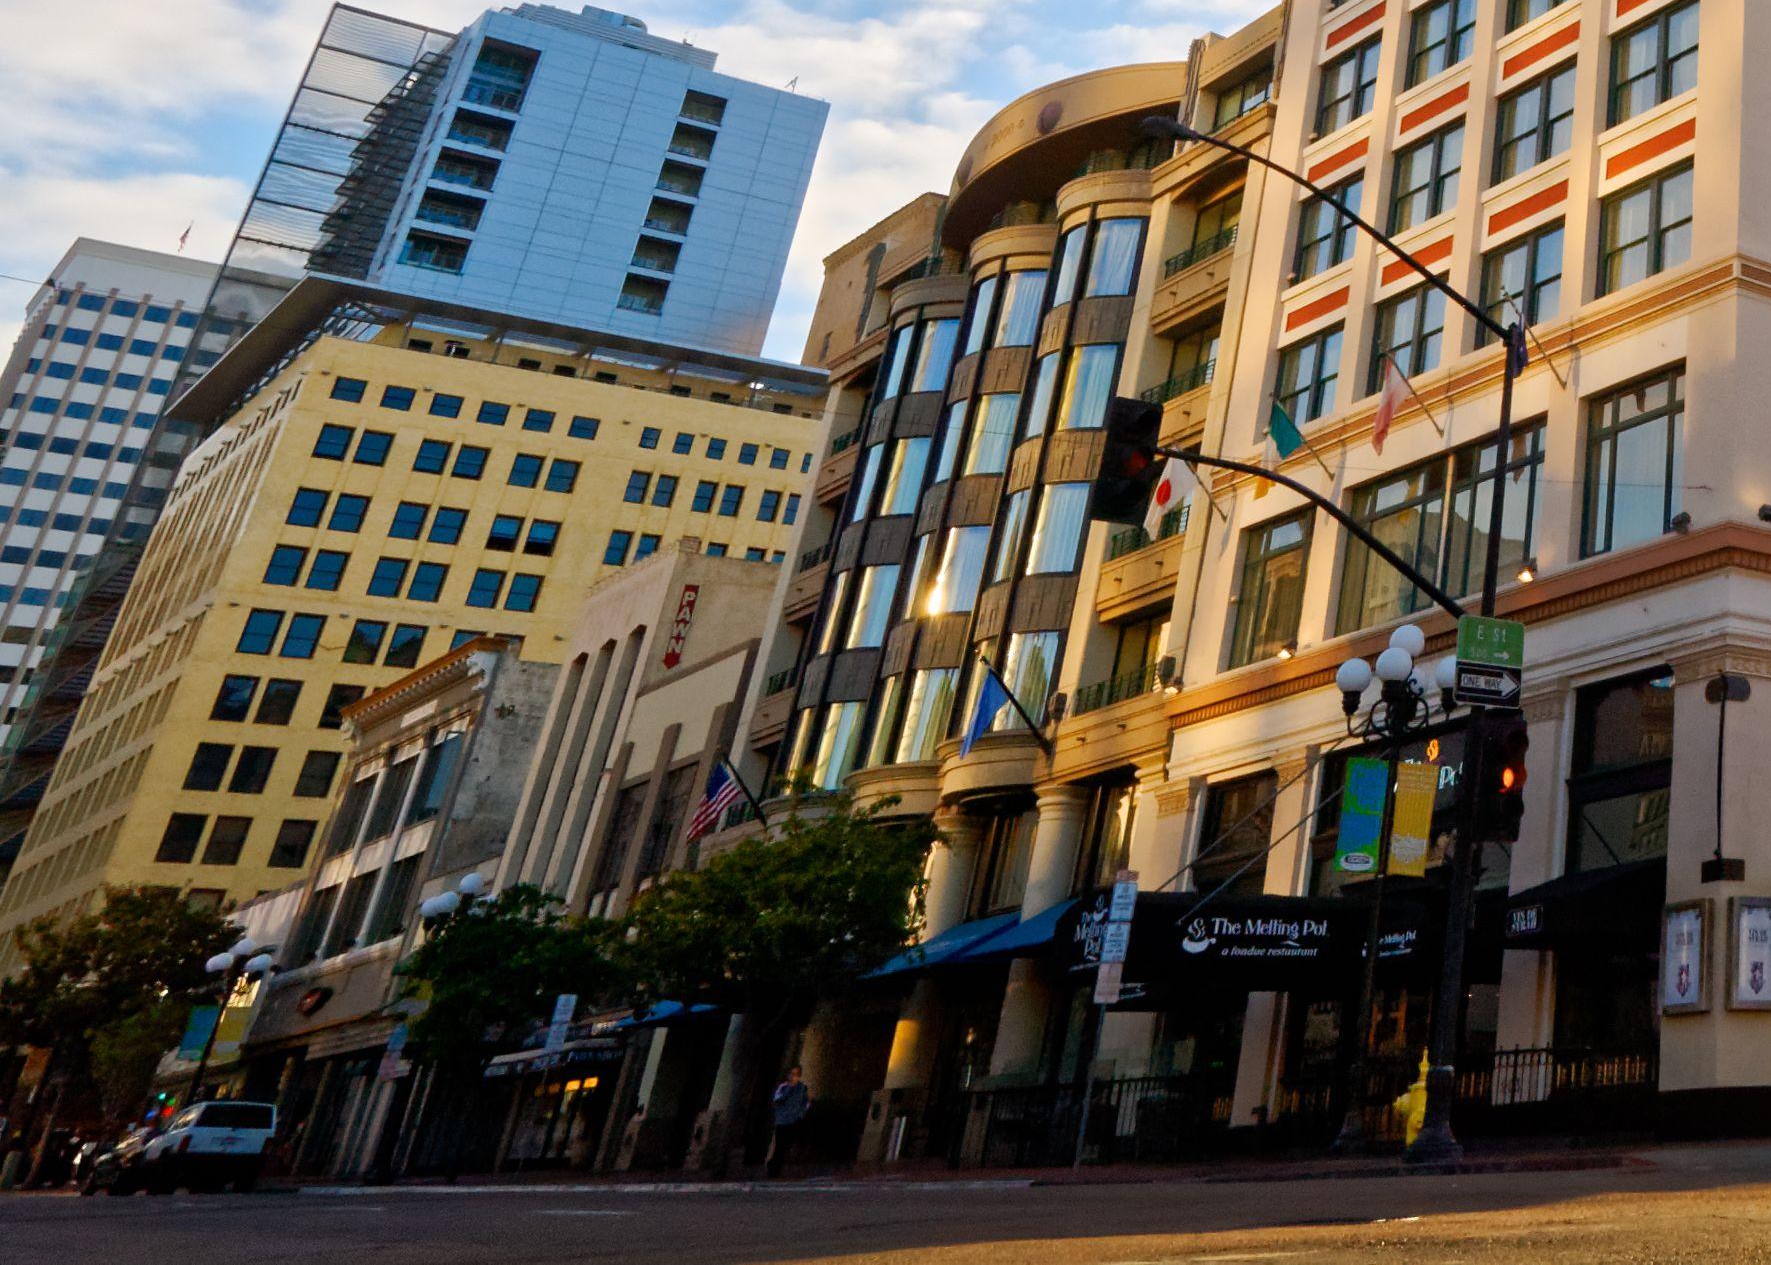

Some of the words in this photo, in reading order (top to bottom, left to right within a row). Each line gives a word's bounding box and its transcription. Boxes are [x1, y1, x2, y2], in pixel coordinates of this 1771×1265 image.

[667, 591, 696, 654] PAWN
[1477, 625, 1484, 640] E
[1493, 628, 1507, 644] St
[1462, 675, 1481, 688] ONE
[1484, 677, 1503, 690] WAY
[1211, 917, 1241, 936] The
[1245, 919, 1300, 940] Melting
[1303, 919, 1328, 936] Pot
[1221, 947, 1229, 956] a
[1231, 945, 1265, 957] fondue
[1267, 946, 1319, 957] restaurant
